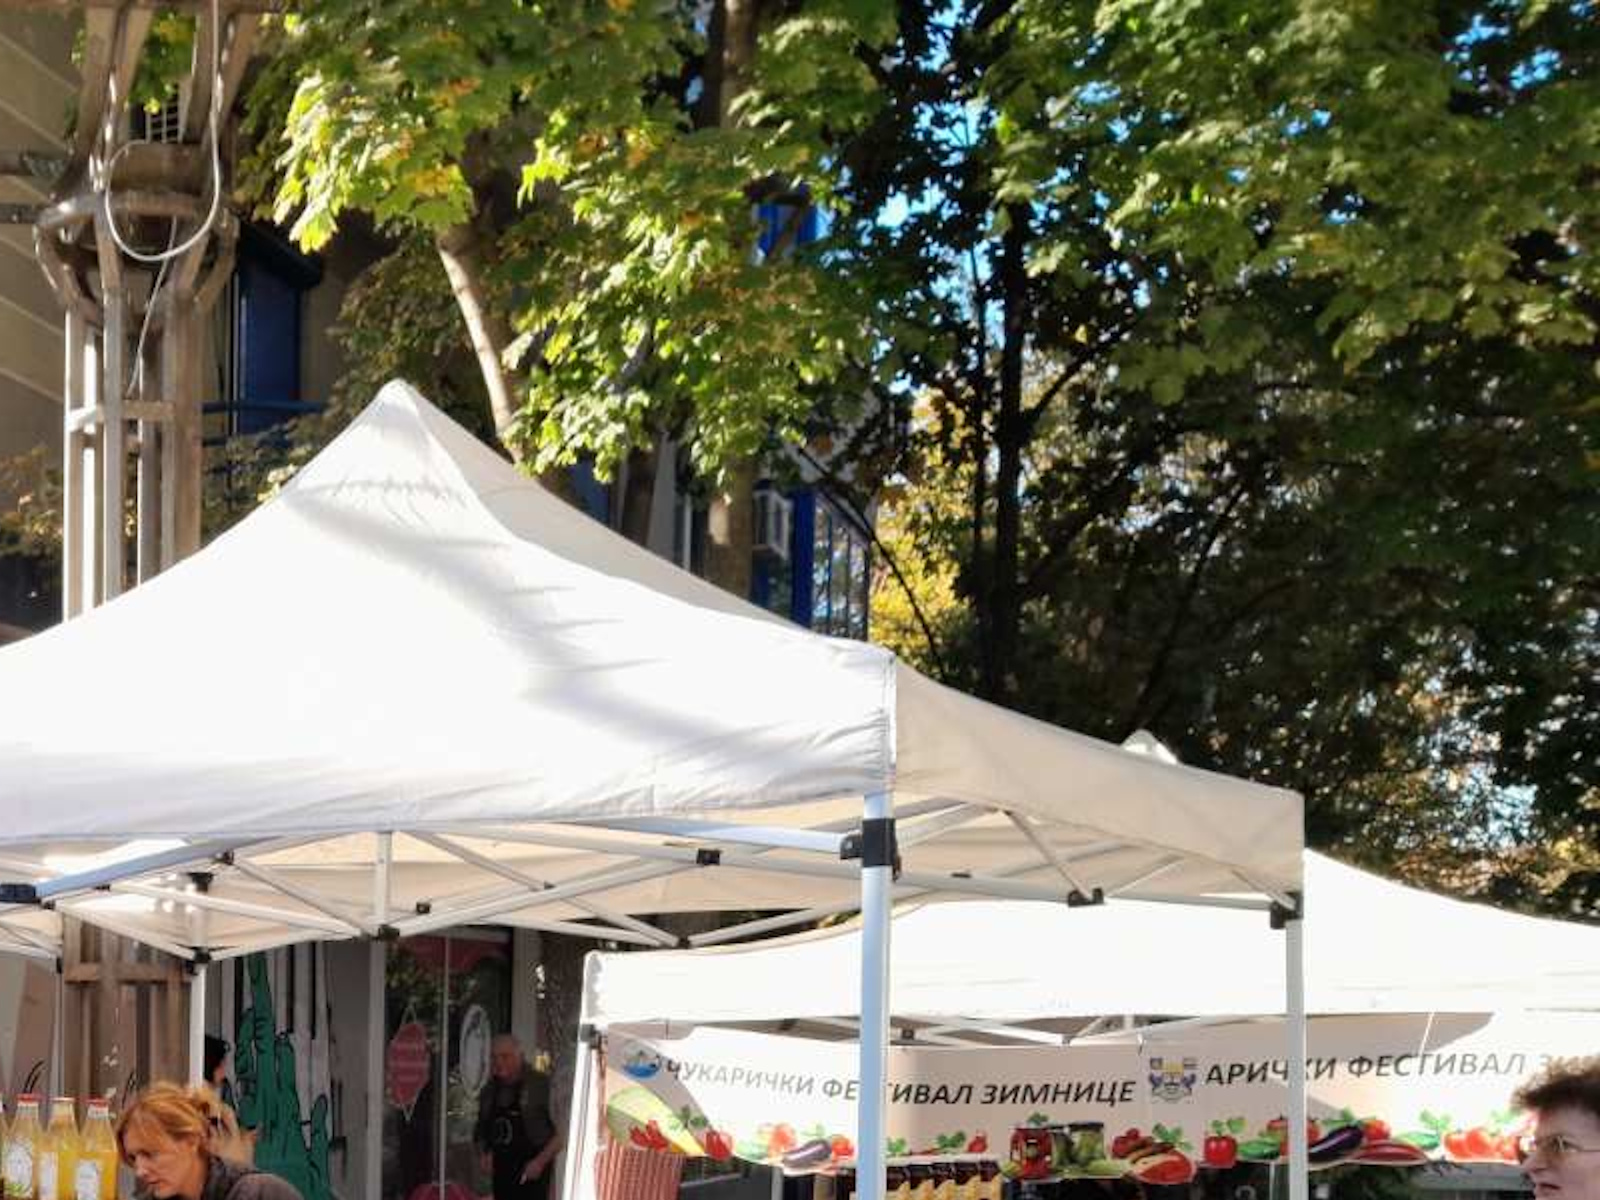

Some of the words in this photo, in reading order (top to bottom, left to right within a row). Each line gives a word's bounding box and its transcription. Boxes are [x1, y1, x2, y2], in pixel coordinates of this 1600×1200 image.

[667, 1058, 814, 1095] ЧУКАРИЧКИ
[822, 1077, 974, 1104] ФЕИВАЛ
[980, 1080, 1137, 1107] ЗИМНИЦЕ
[1348, 1052, 1526, 1077] ФЕСТИВАЛ
